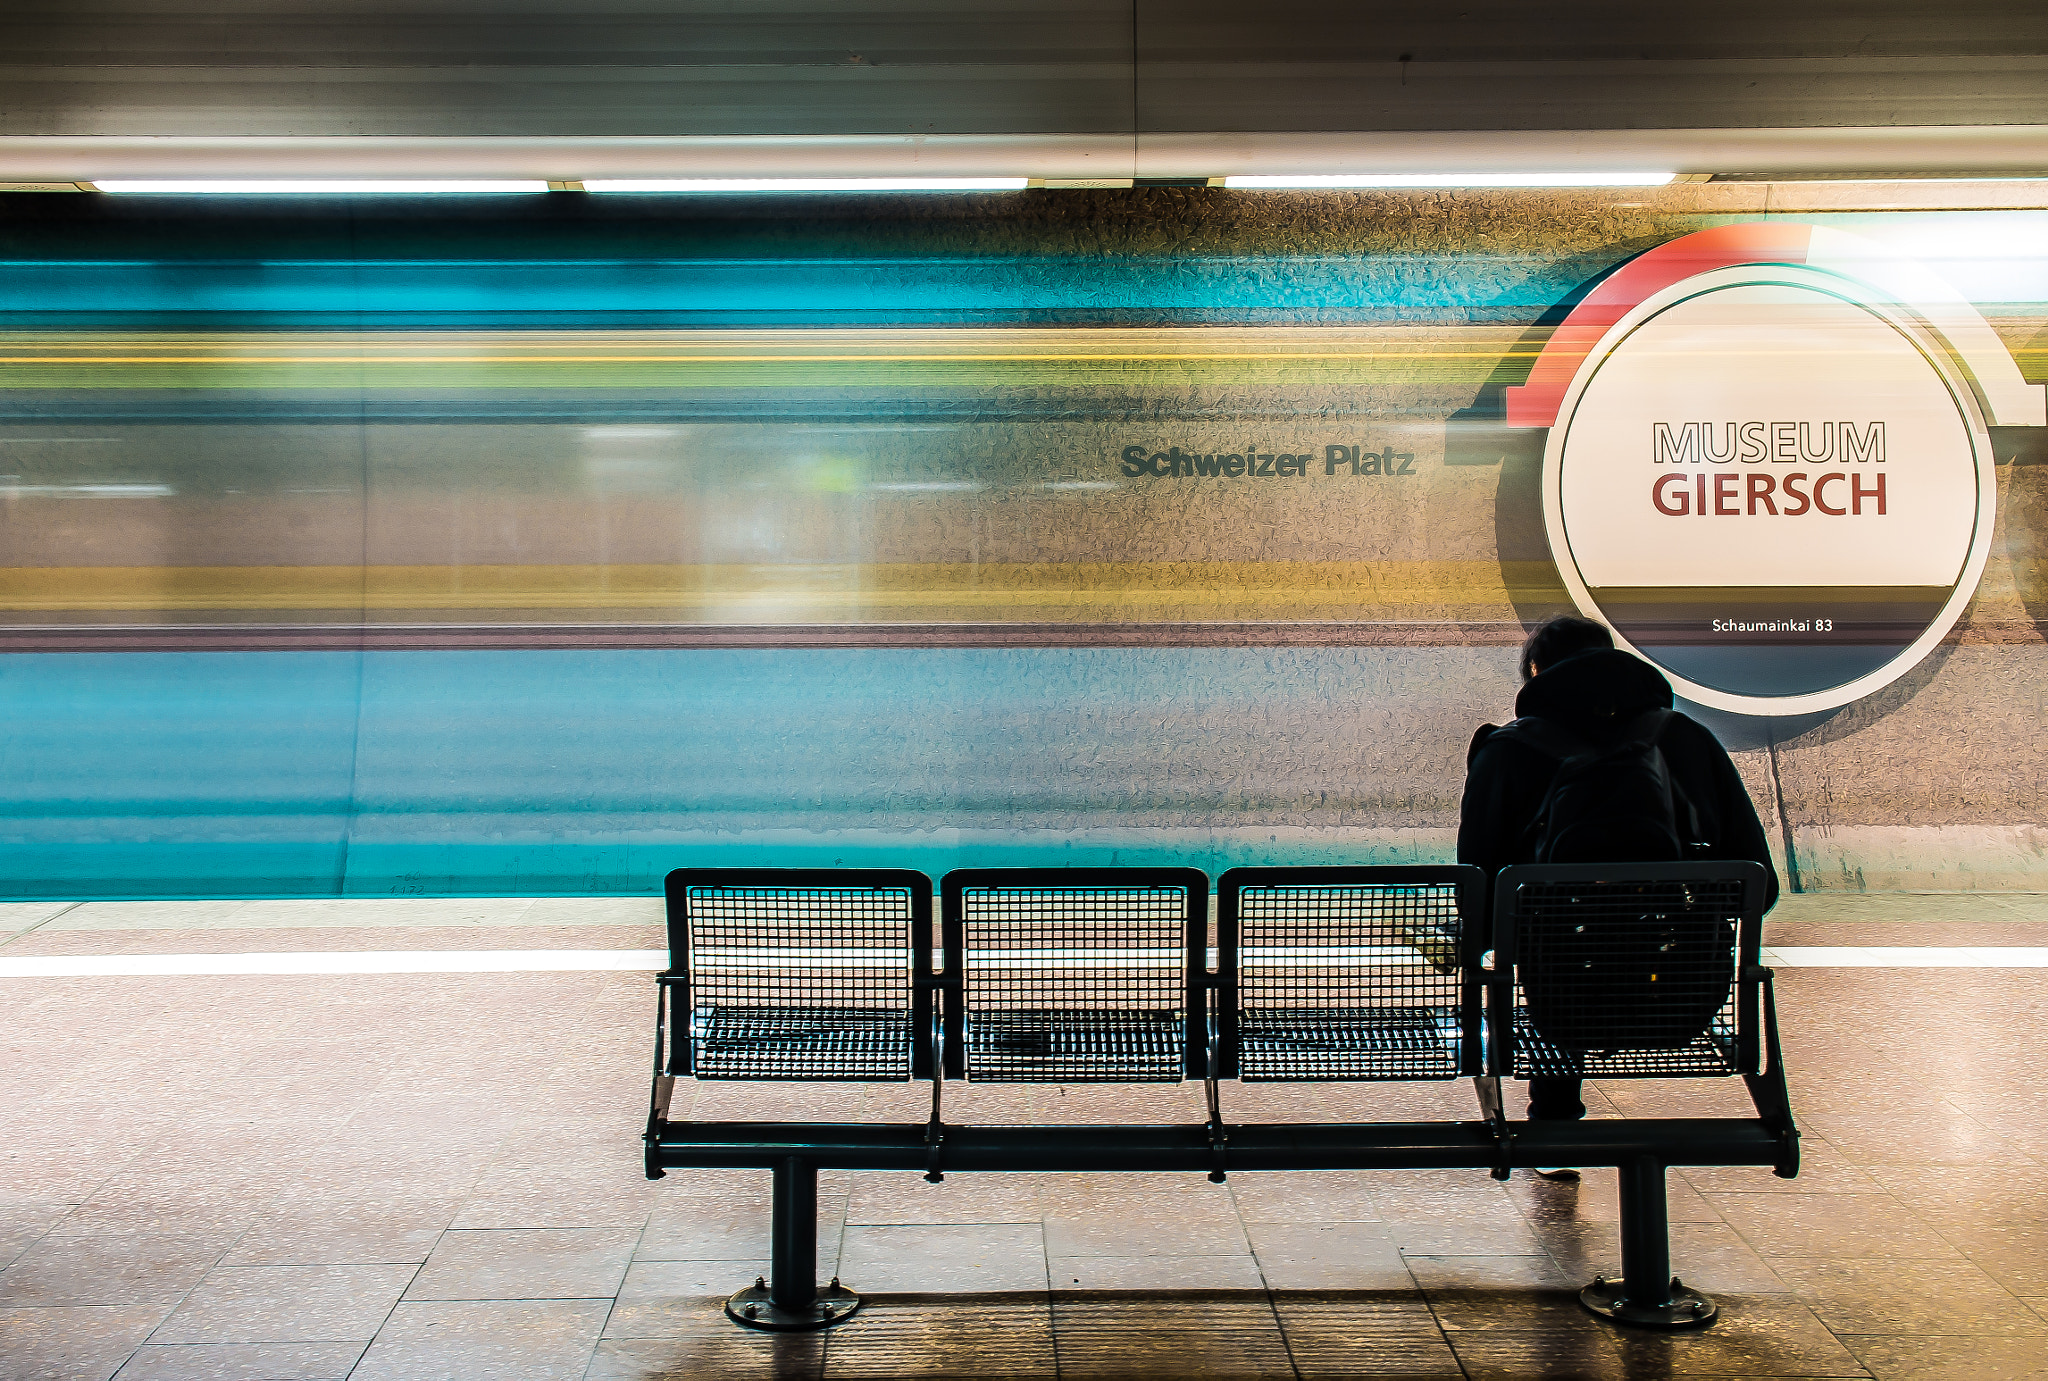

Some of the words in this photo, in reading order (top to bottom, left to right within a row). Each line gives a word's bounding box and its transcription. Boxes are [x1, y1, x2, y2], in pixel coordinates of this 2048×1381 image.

[1653, 422, 1886, 463] MUSEUM
[1121, 445, 1313, 477] Schweizer
[1325, 445, 1416, 476] Platz
[1652, 473, 1887, 516] GIERSCH
[1712, 619, 1810, 632] Schaumainkai
[1815, 619, 1833, 632] 83
